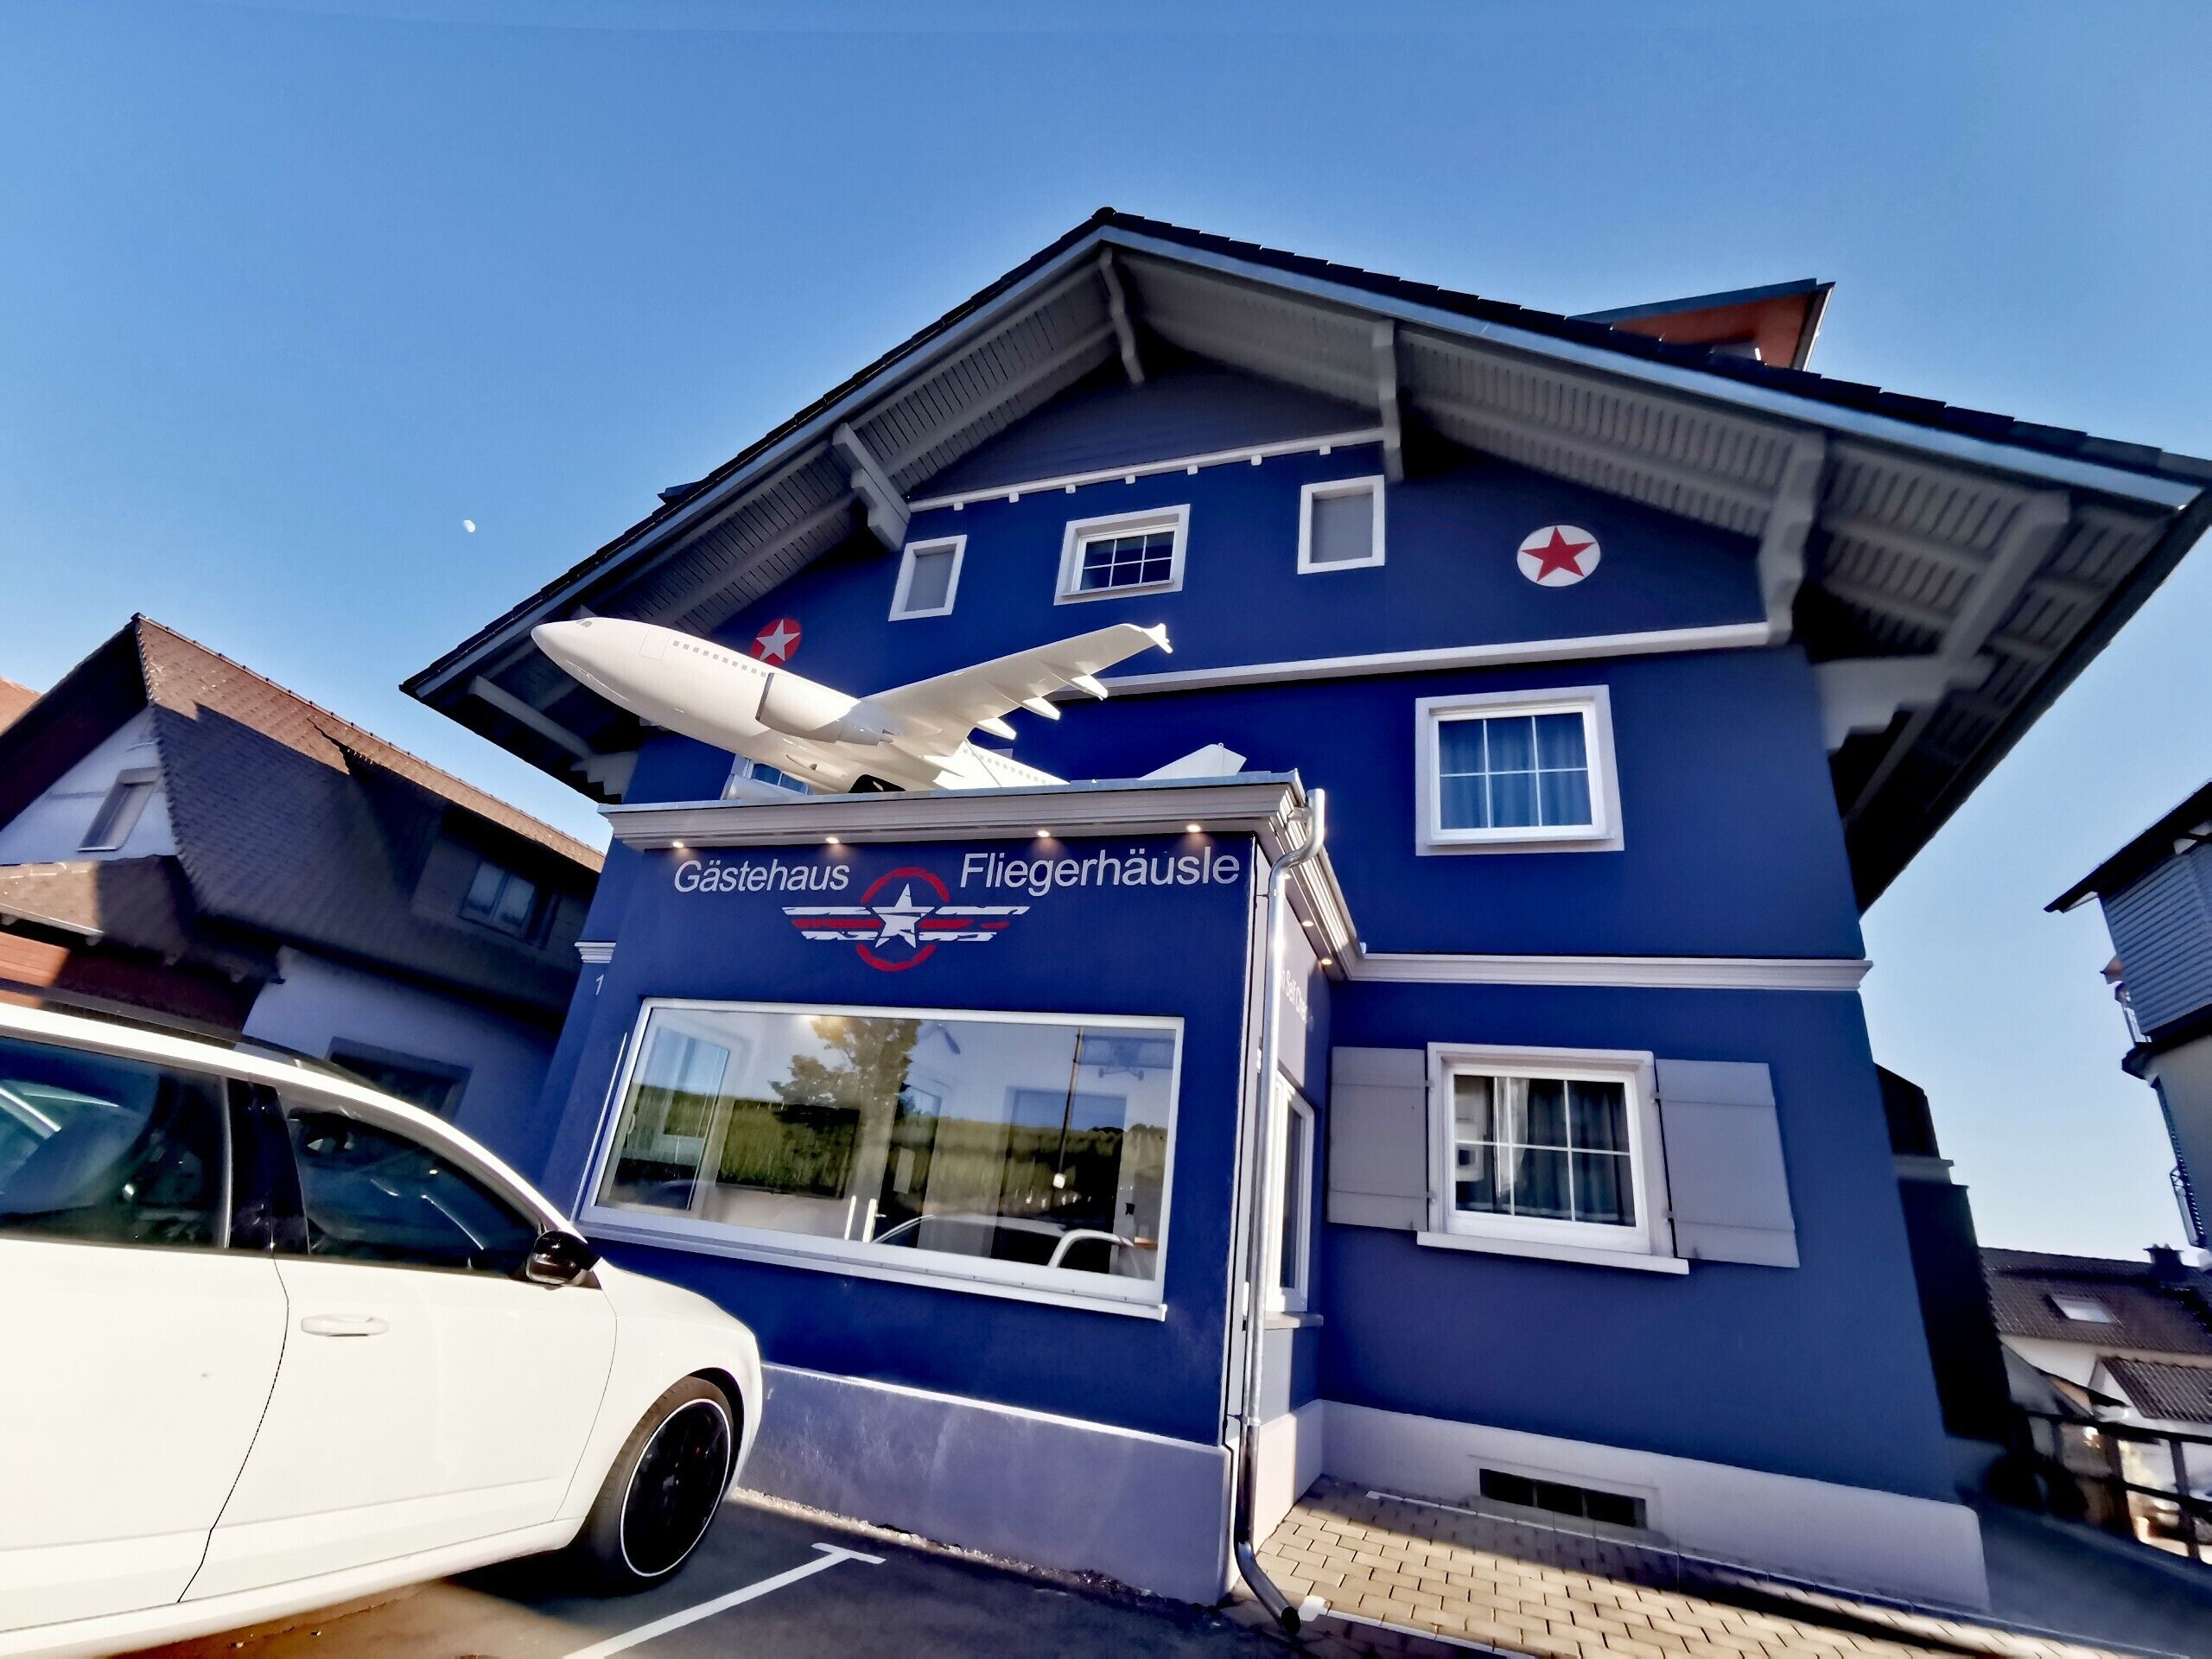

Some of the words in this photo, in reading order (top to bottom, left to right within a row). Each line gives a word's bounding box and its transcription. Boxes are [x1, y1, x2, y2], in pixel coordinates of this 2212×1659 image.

[674, 859, 850, 893] Gästehaus
[960, 846, 1240, 897] Fliegerhäusle
[595, 973, 604, 995] 1
